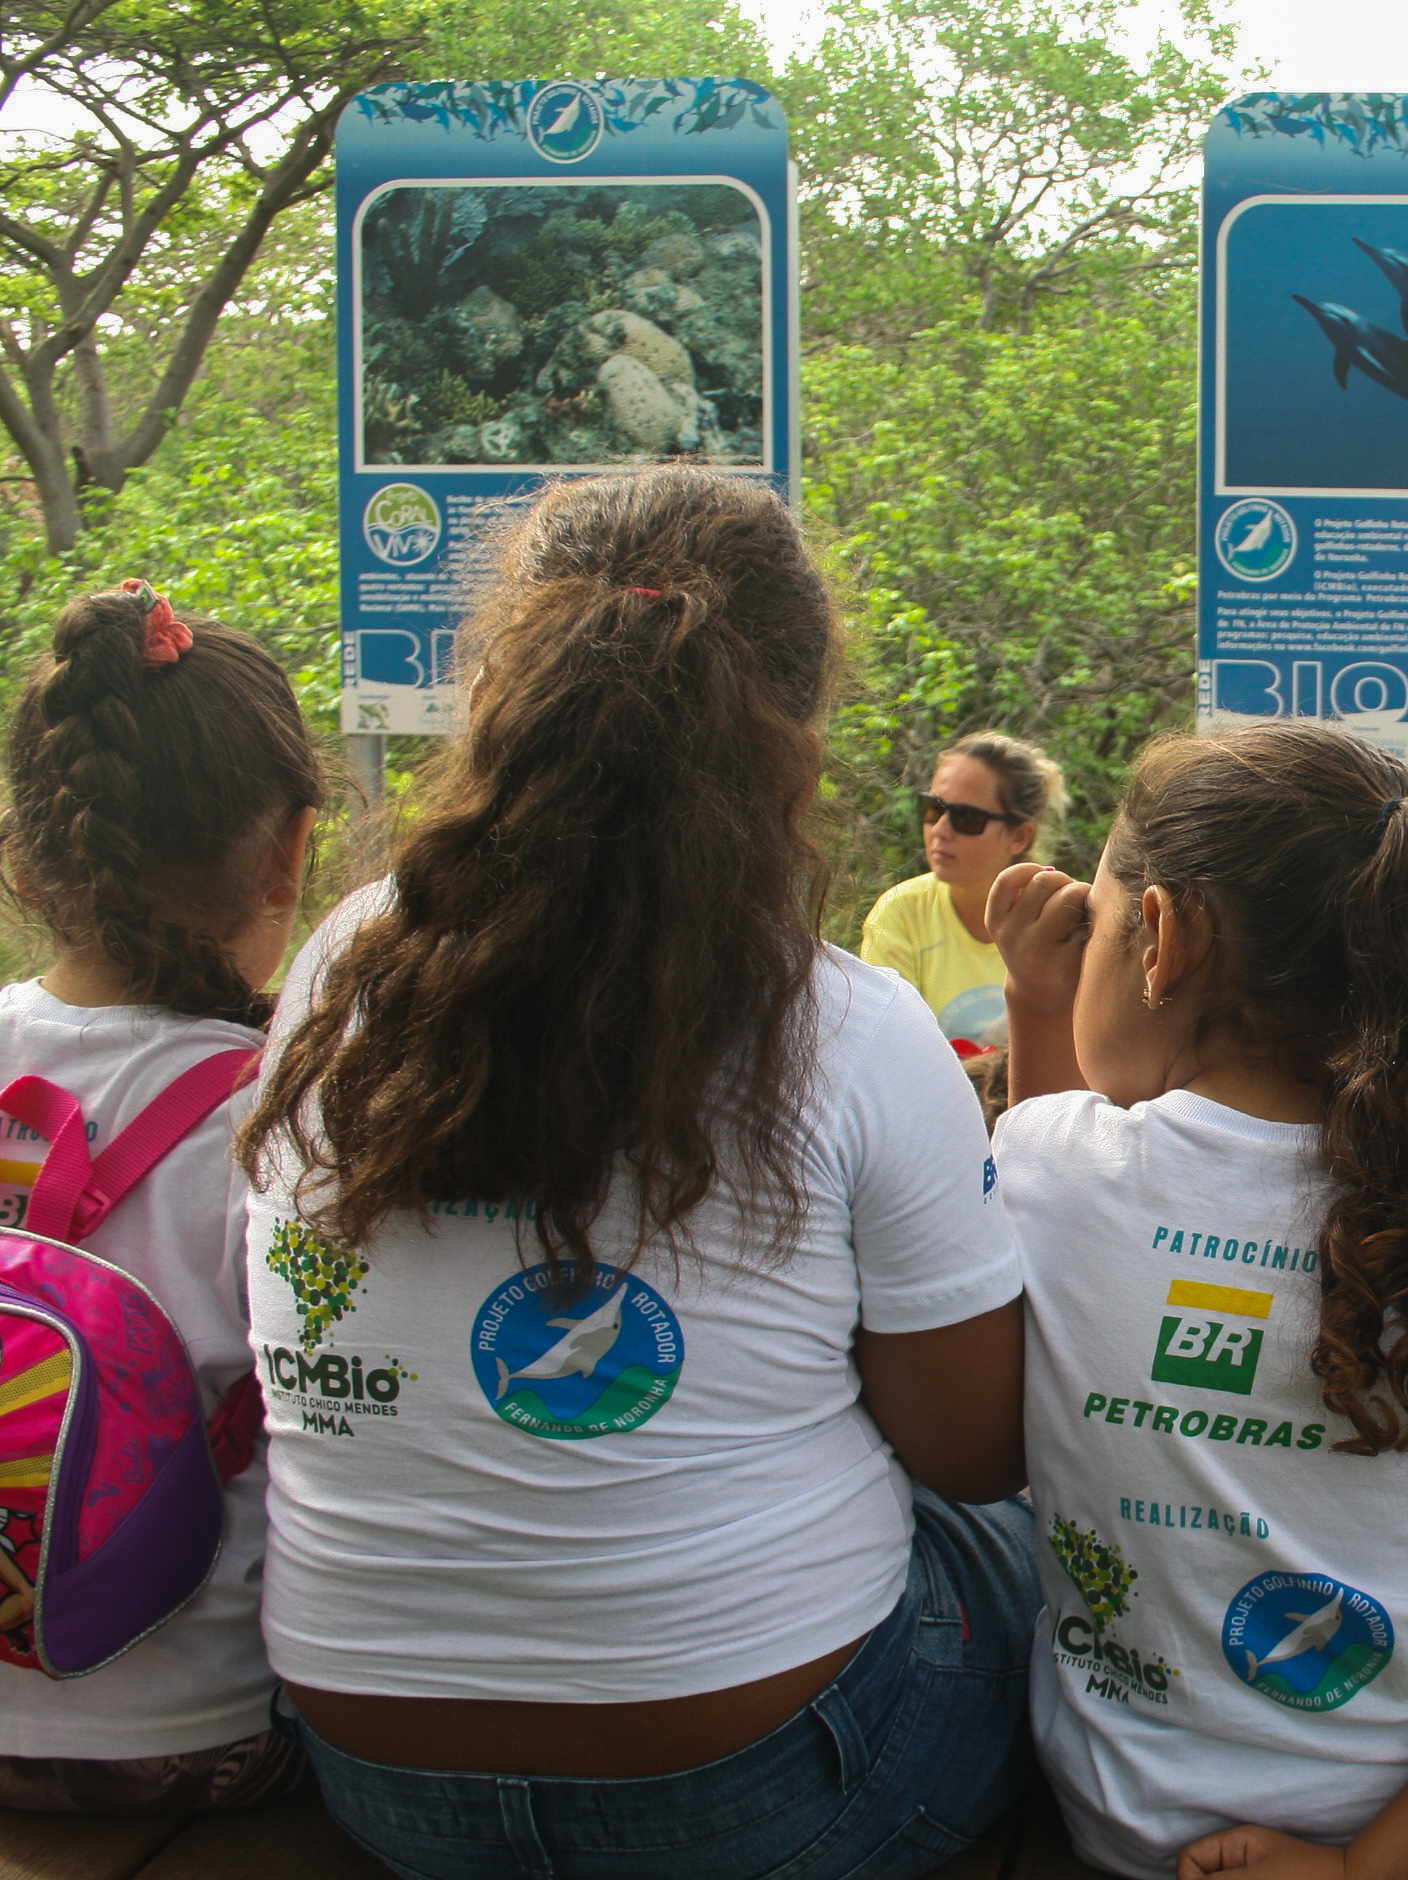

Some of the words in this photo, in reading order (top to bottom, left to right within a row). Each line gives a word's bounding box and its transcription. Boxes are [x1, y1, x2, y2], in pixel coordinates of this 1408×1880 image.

[1152, 1226, 1320, 1274] PATROCÍNIO
[478, 1285, 525, 1351] PROJETO
[631, 1291, 677, 1364] ROTADOR
[1165, 1317, 1253, 1366] BR
[264, 1344, 400, 1403] ICMBio
[302, 1410, 355, 1437] MMA
[309, 1397, 340, 1412] CHICO
[345, 1402, 398, 1417] MENDES
[505, 1402, 584, 1433] FERNANDO
[588, 1422, 609, 1432] DE
[614, 1378, 669, 1428] NORONHA
[1083, 1392, 1326, 1450] PETROBRAS
[1120, 1497, 1270, 1540] REALIZAÇÃO
[1229, 1585, 1265, 1647] PROJETO
[1263, 1574, 1334, 1597] GOLFINHO
[1347, 1592, 1388, 1648] ROTADOR
[1052, 1652, 1100, 1673] STITUTO
[1103, 1665, 1129, 1686] CHICO
[1256, 1682, 1322, 1707] FERNANDO
[1325, 1687, 1343, 1702] DE
